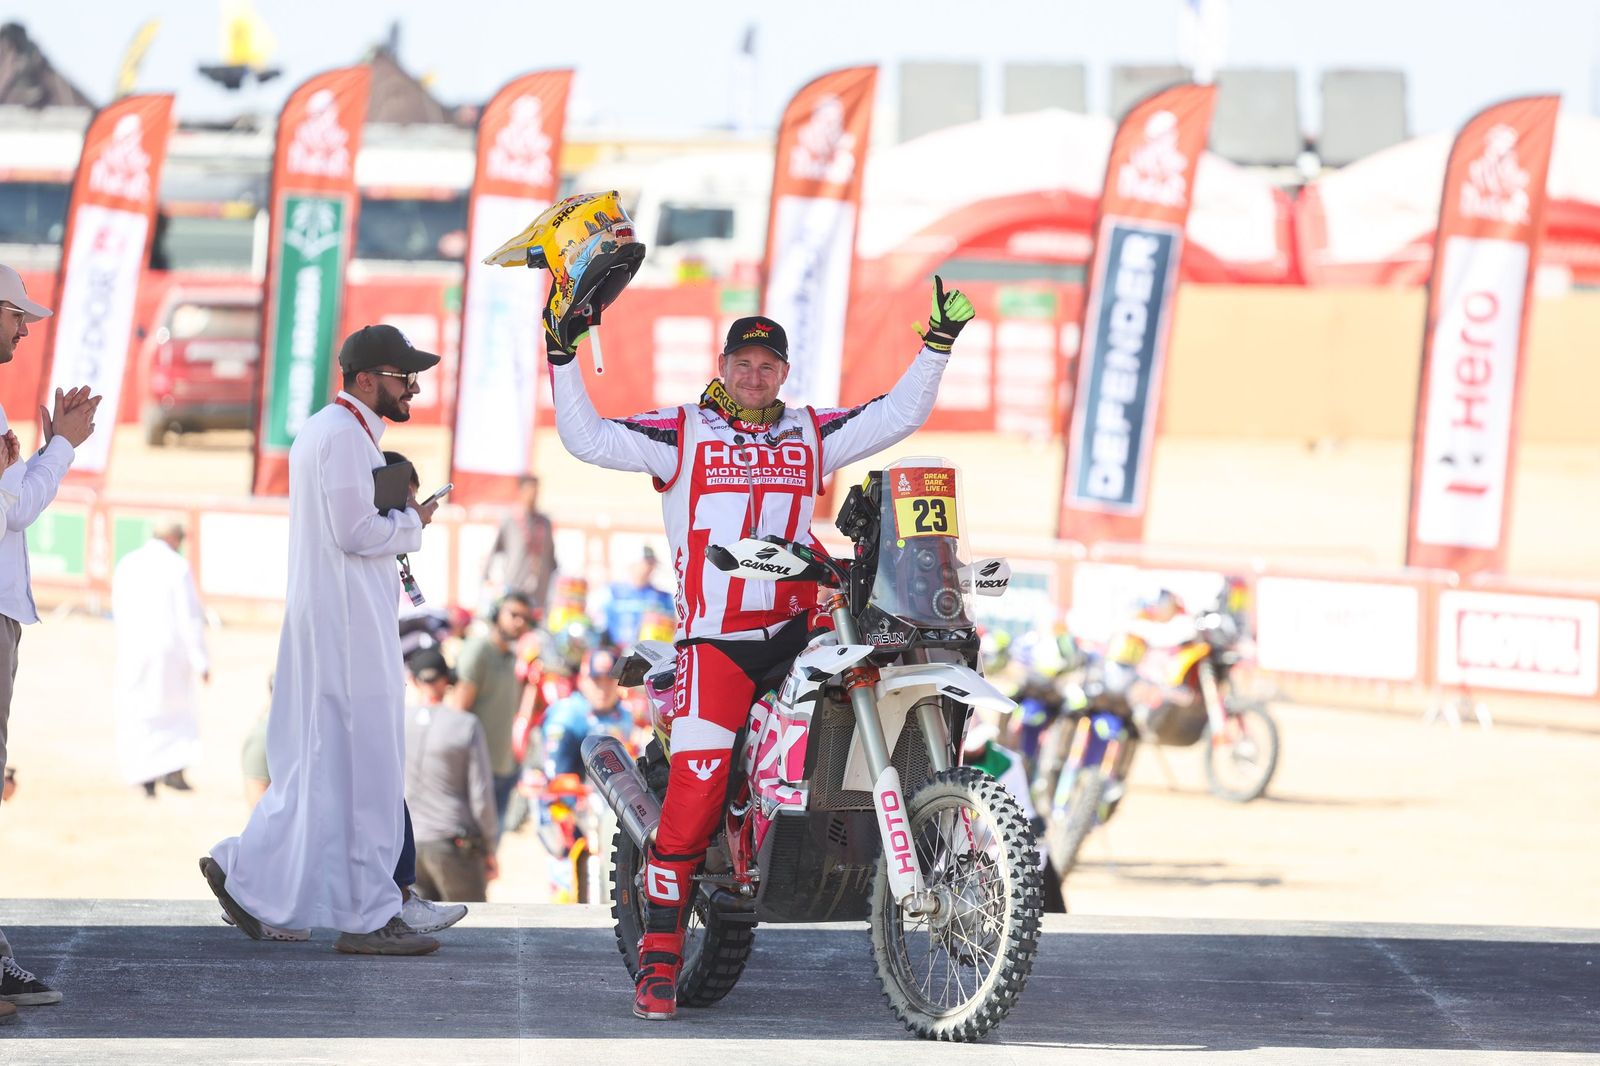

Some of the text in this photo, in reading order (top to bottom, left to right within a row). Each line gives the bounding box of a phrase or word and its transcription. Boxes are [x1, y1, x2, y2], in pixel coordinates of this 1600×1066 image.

[1086, 233, 1160, 499] DEFENDER
[1451, 290, 1499, 431] Hero
[704, 445, 807, 466] HOTO
[706, 467, 807, 477] MOTORCYCLE
[782, 477, 803, 485] TEAM
[913, 498, 948, 533] 23
[740, 559, 791, 576] GANSOUL
[880, 790, 916, 875] HOTO
